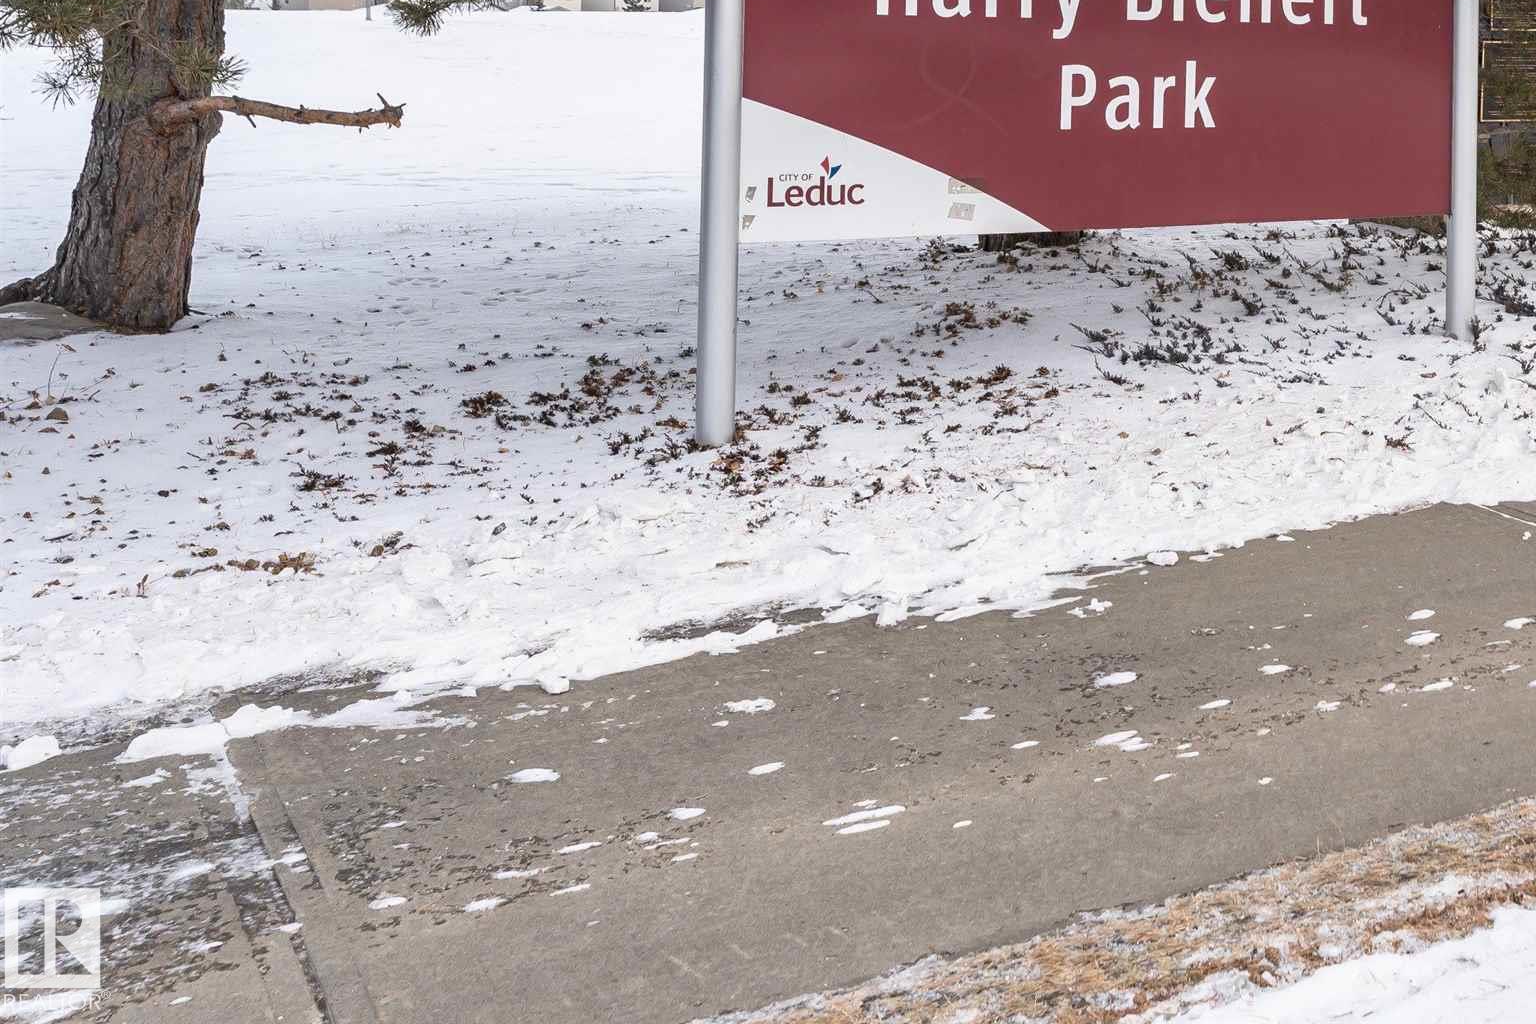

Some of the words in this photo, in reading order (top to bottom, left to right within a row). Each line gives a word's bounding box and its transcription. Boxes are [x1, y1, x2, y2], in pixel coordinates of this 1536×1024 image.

[1061, 61, 1216, 130] Park
[767, 176, 865, 207] Leduc
[779, 173, 799, 182] CITY
[801, 173, 814, 182] OF
